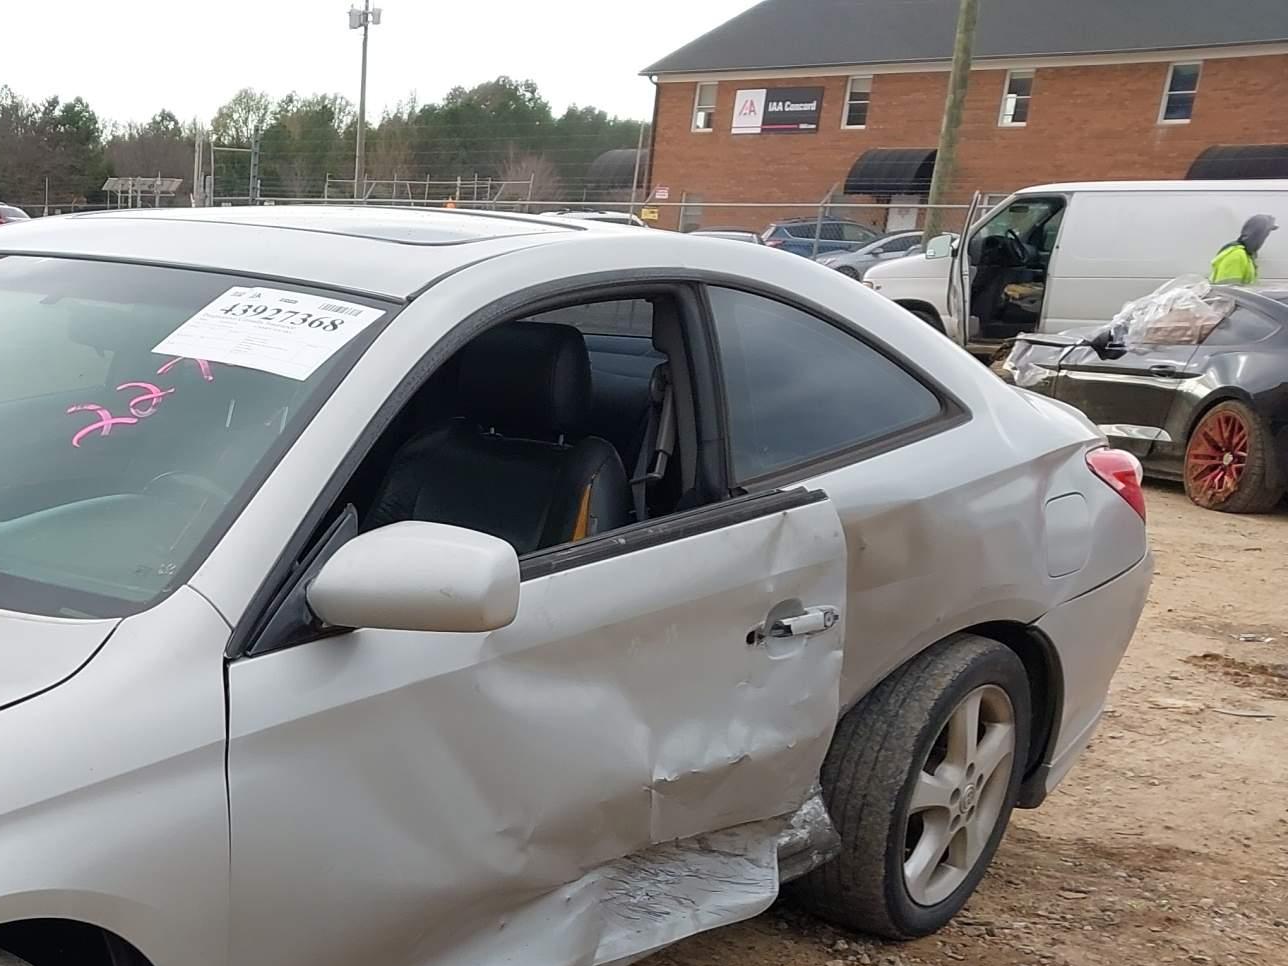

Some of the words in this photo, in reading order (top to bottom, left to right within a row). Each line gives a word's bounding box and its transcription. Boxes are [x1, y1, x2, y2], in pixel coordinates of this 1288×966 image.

[768, 102, 783, 112] IAA
[784, 100, 817, 112] Concord
[219, 302, 346, 333] 43927368
